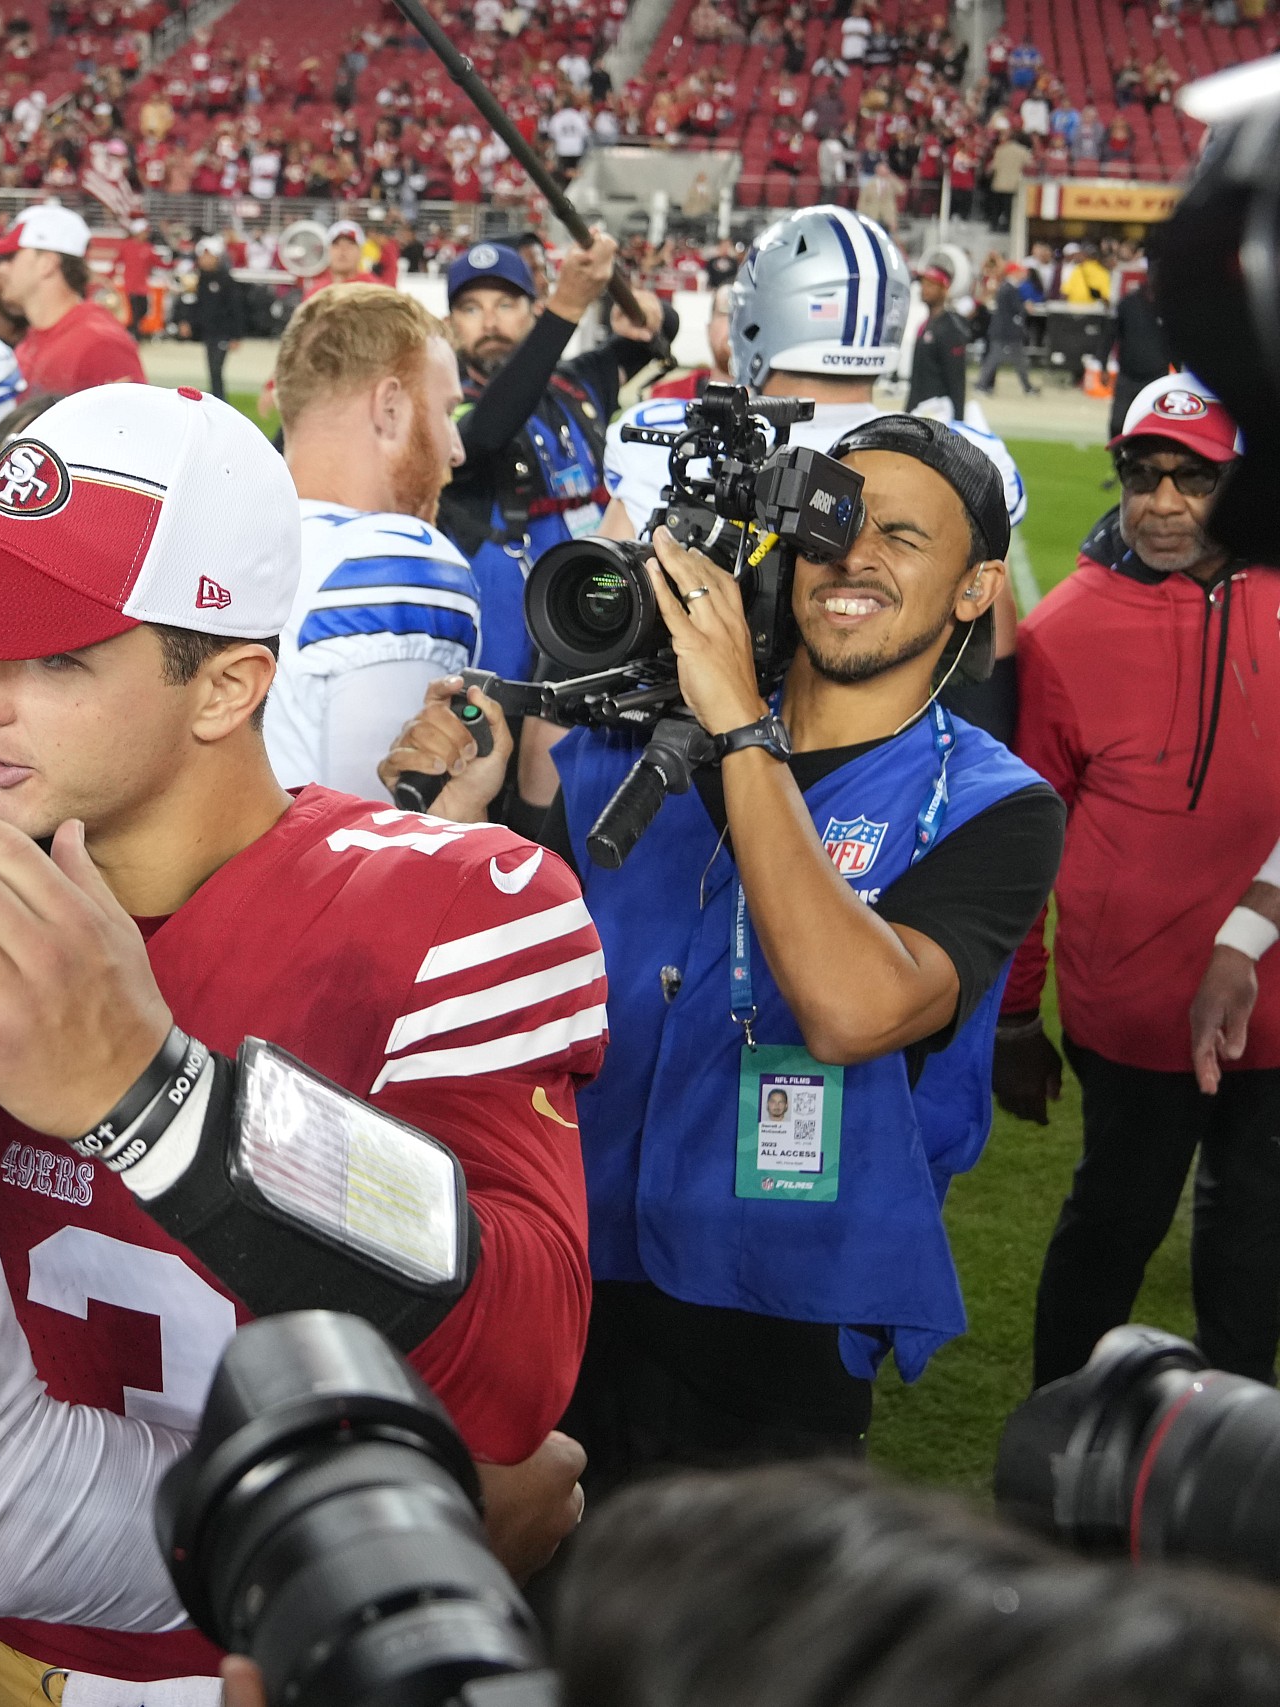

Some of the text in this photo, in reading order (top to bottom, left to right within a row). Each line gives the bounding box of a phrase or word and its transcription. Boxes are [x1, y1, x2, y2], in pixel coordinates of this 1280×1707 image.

[822, 354, 886, 367] COWBOYS
[809, 488, 834, 515] ARRI
[736, 923, 745, 959] LEAGUE
[168, 1076, 191, 1106] DO
[184, 1049, 204, 1079] NOT
[775, 1076, 811, 1085] NFL FILMS
[780, 1150, 817, 1158] ACCESS
[1, 1140, 95, 1207] 49ERS
[776, 1179, 814, 1190] FILMS
